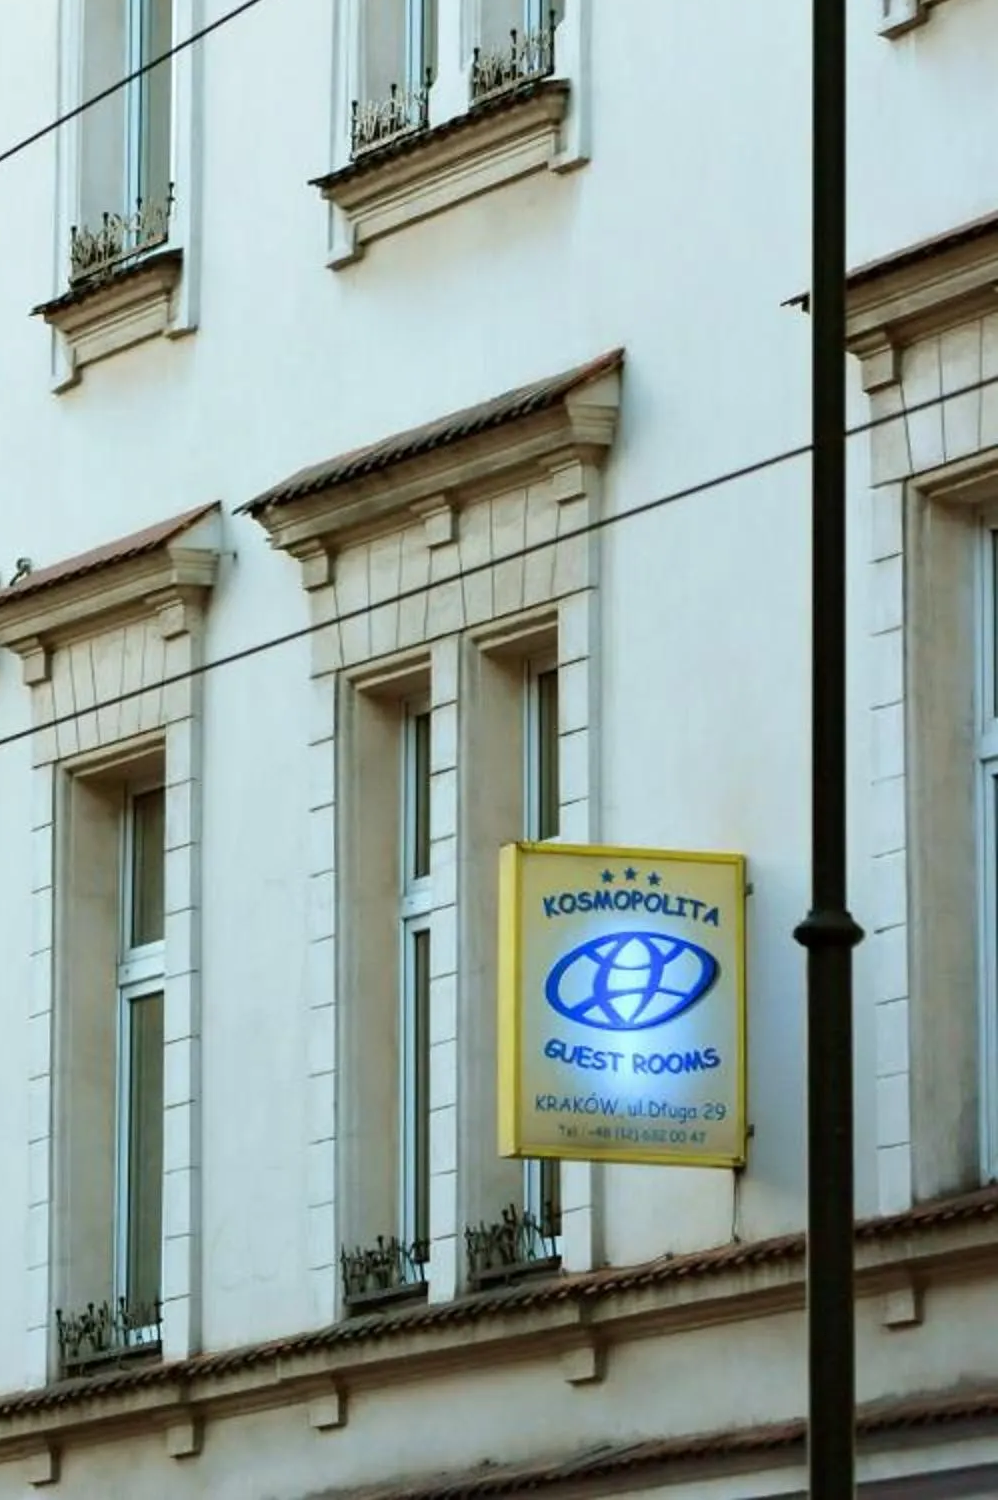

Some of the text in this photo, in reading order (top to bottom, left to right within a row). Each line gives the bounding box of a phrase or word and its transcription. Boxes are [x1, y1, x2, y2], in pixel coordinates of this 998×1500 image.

[543, 889, 719, 926] KOSMOPOLITA
[544, 1038, 721, 1074] GUEST ROOMS
[702, 1102, 726, 1121] 29
[669, 1129, 687, 1143] 00
